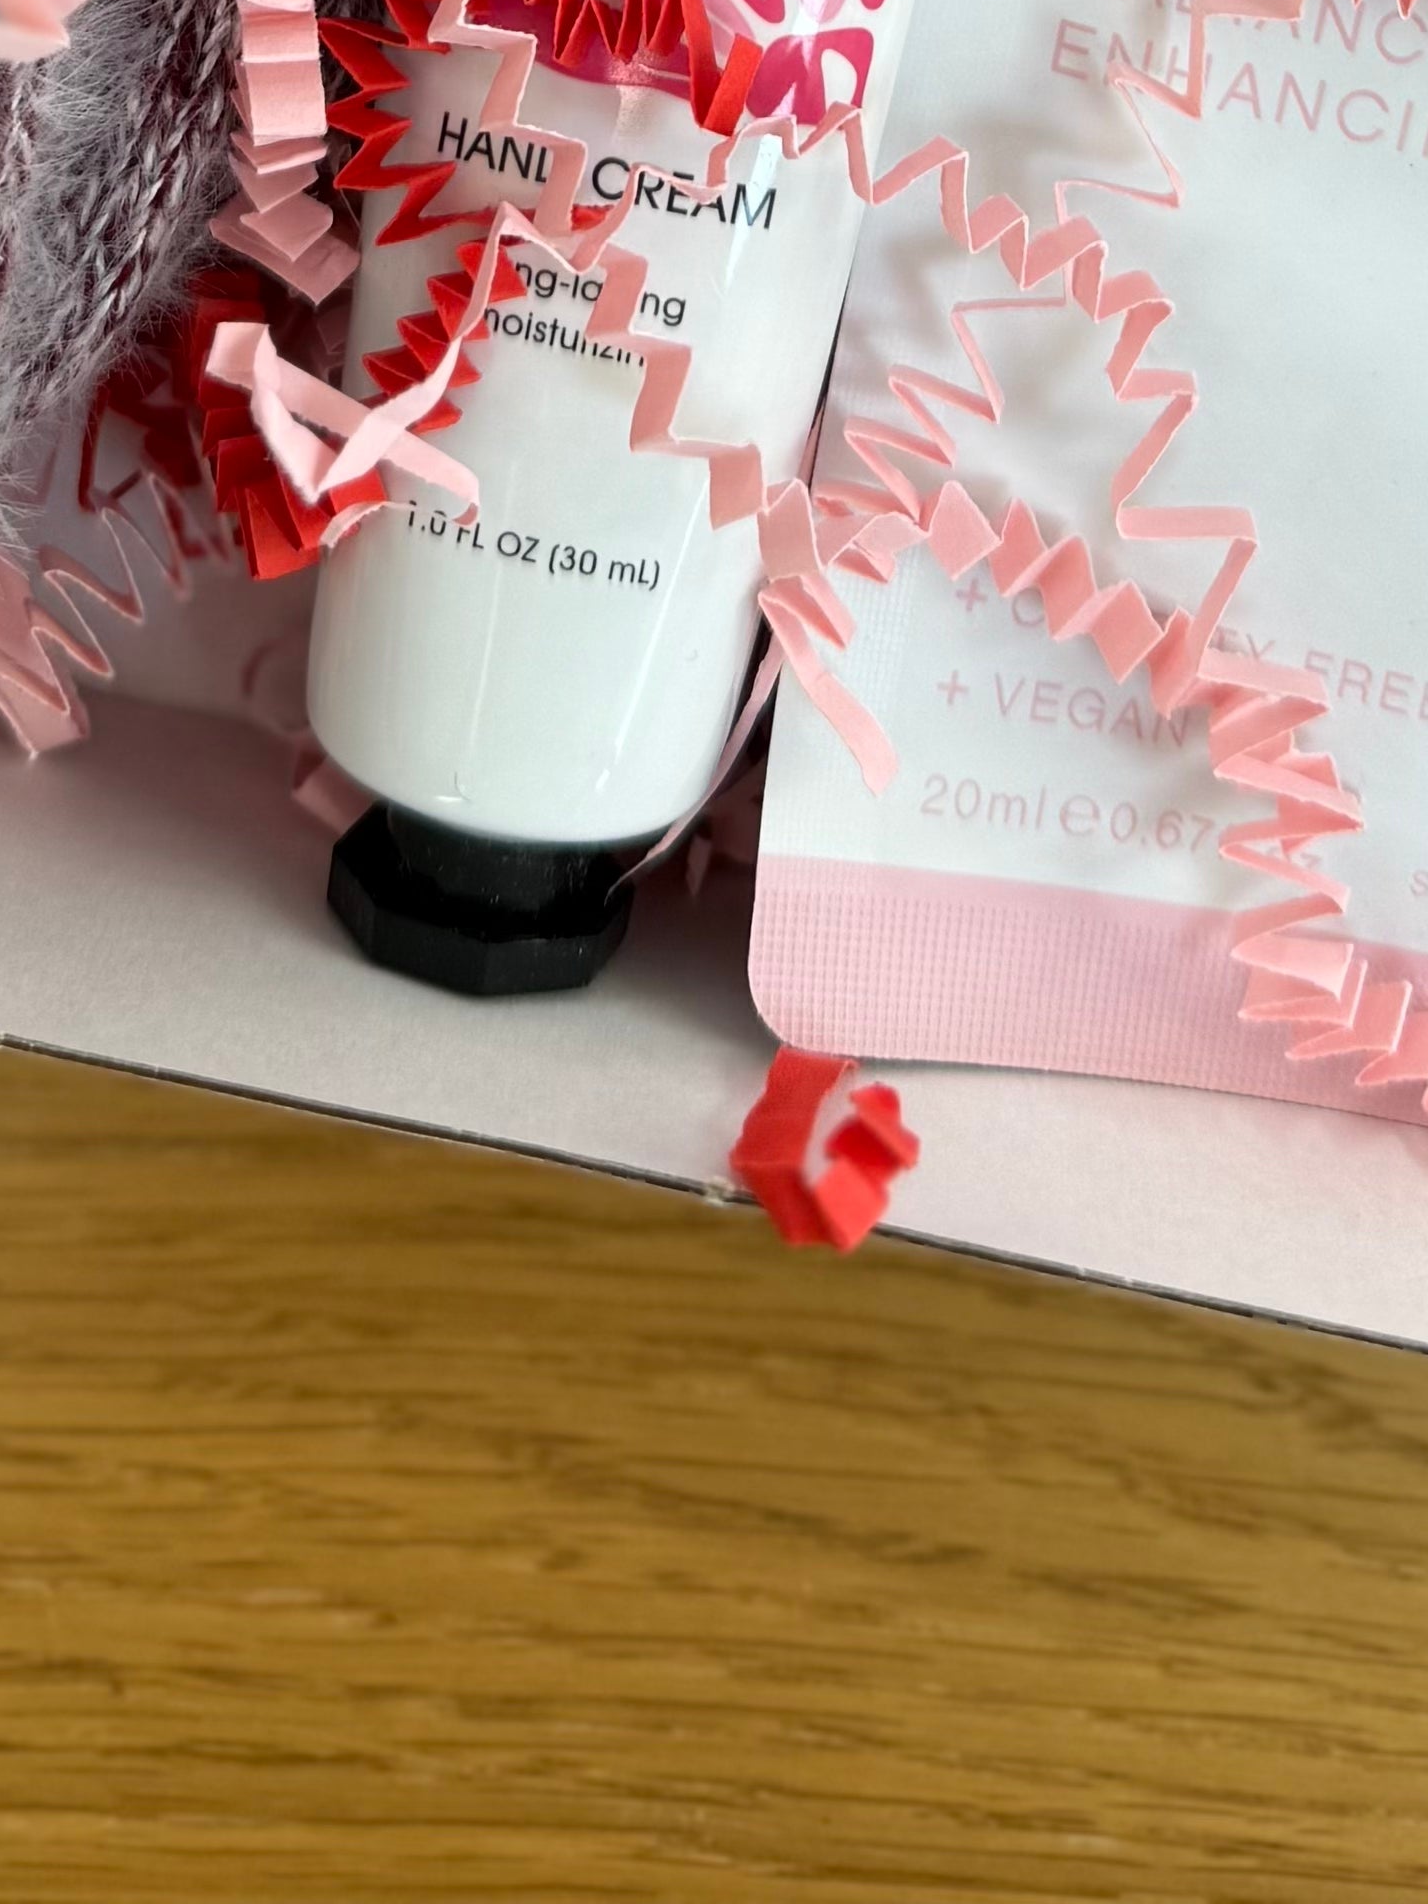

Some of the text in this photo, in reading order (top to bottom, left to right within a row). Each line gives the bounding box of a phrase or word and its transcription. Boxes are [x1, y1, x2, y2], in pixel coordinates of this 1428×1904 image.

[497, 531, 540, 563] OZ
[548, 543, 598, 576] (30
[608, 558, 660, 591] mL)
[994, 672, 1190, 748] VEGAN
